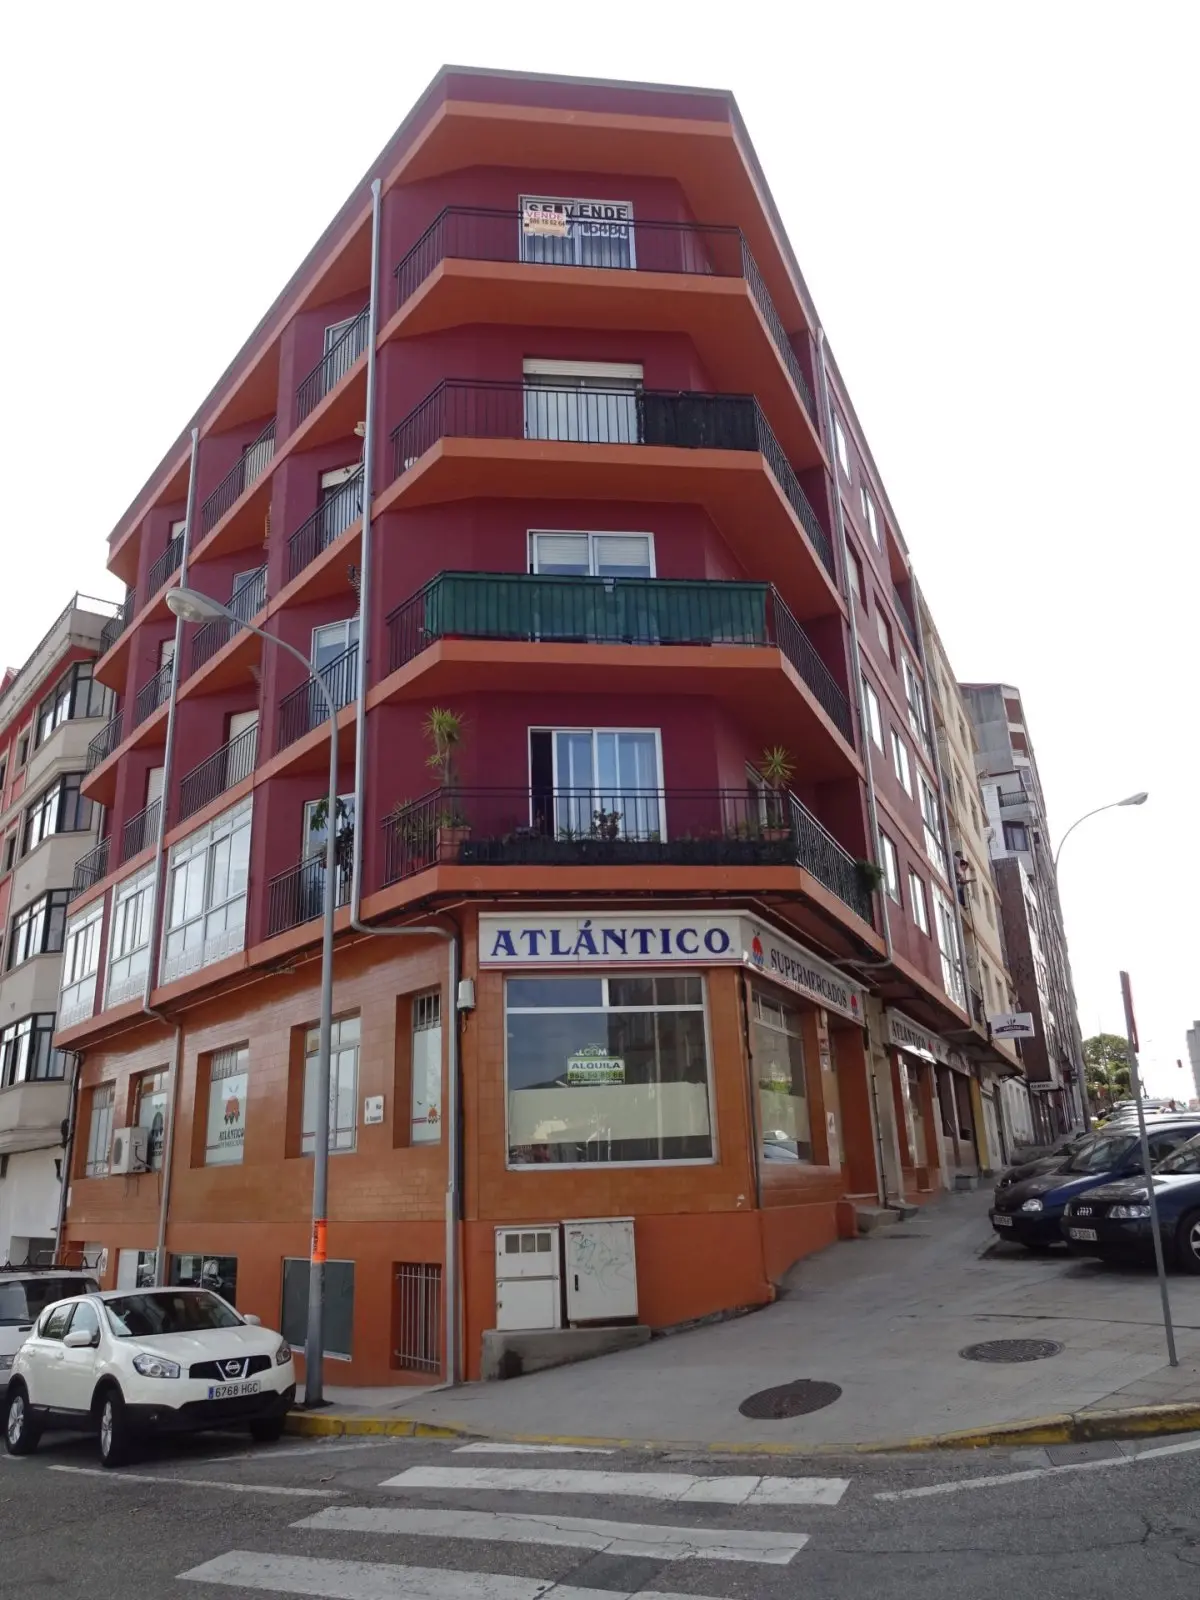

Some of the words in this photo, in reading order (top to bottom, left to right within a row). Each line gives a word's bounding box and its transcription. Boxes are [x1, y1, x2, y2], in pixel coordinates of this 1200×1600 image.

[527, 211, 562, 220] VENDE
[564, 204, 628, 221] VENDE
[490, 919, 731, 957] ATLÁNTICO
[770, 948, 848, 1009] SUPERMERCADOS
[215, 1385, 239, 1397] 6768
[241, 1382, 258, 1394] HGC
